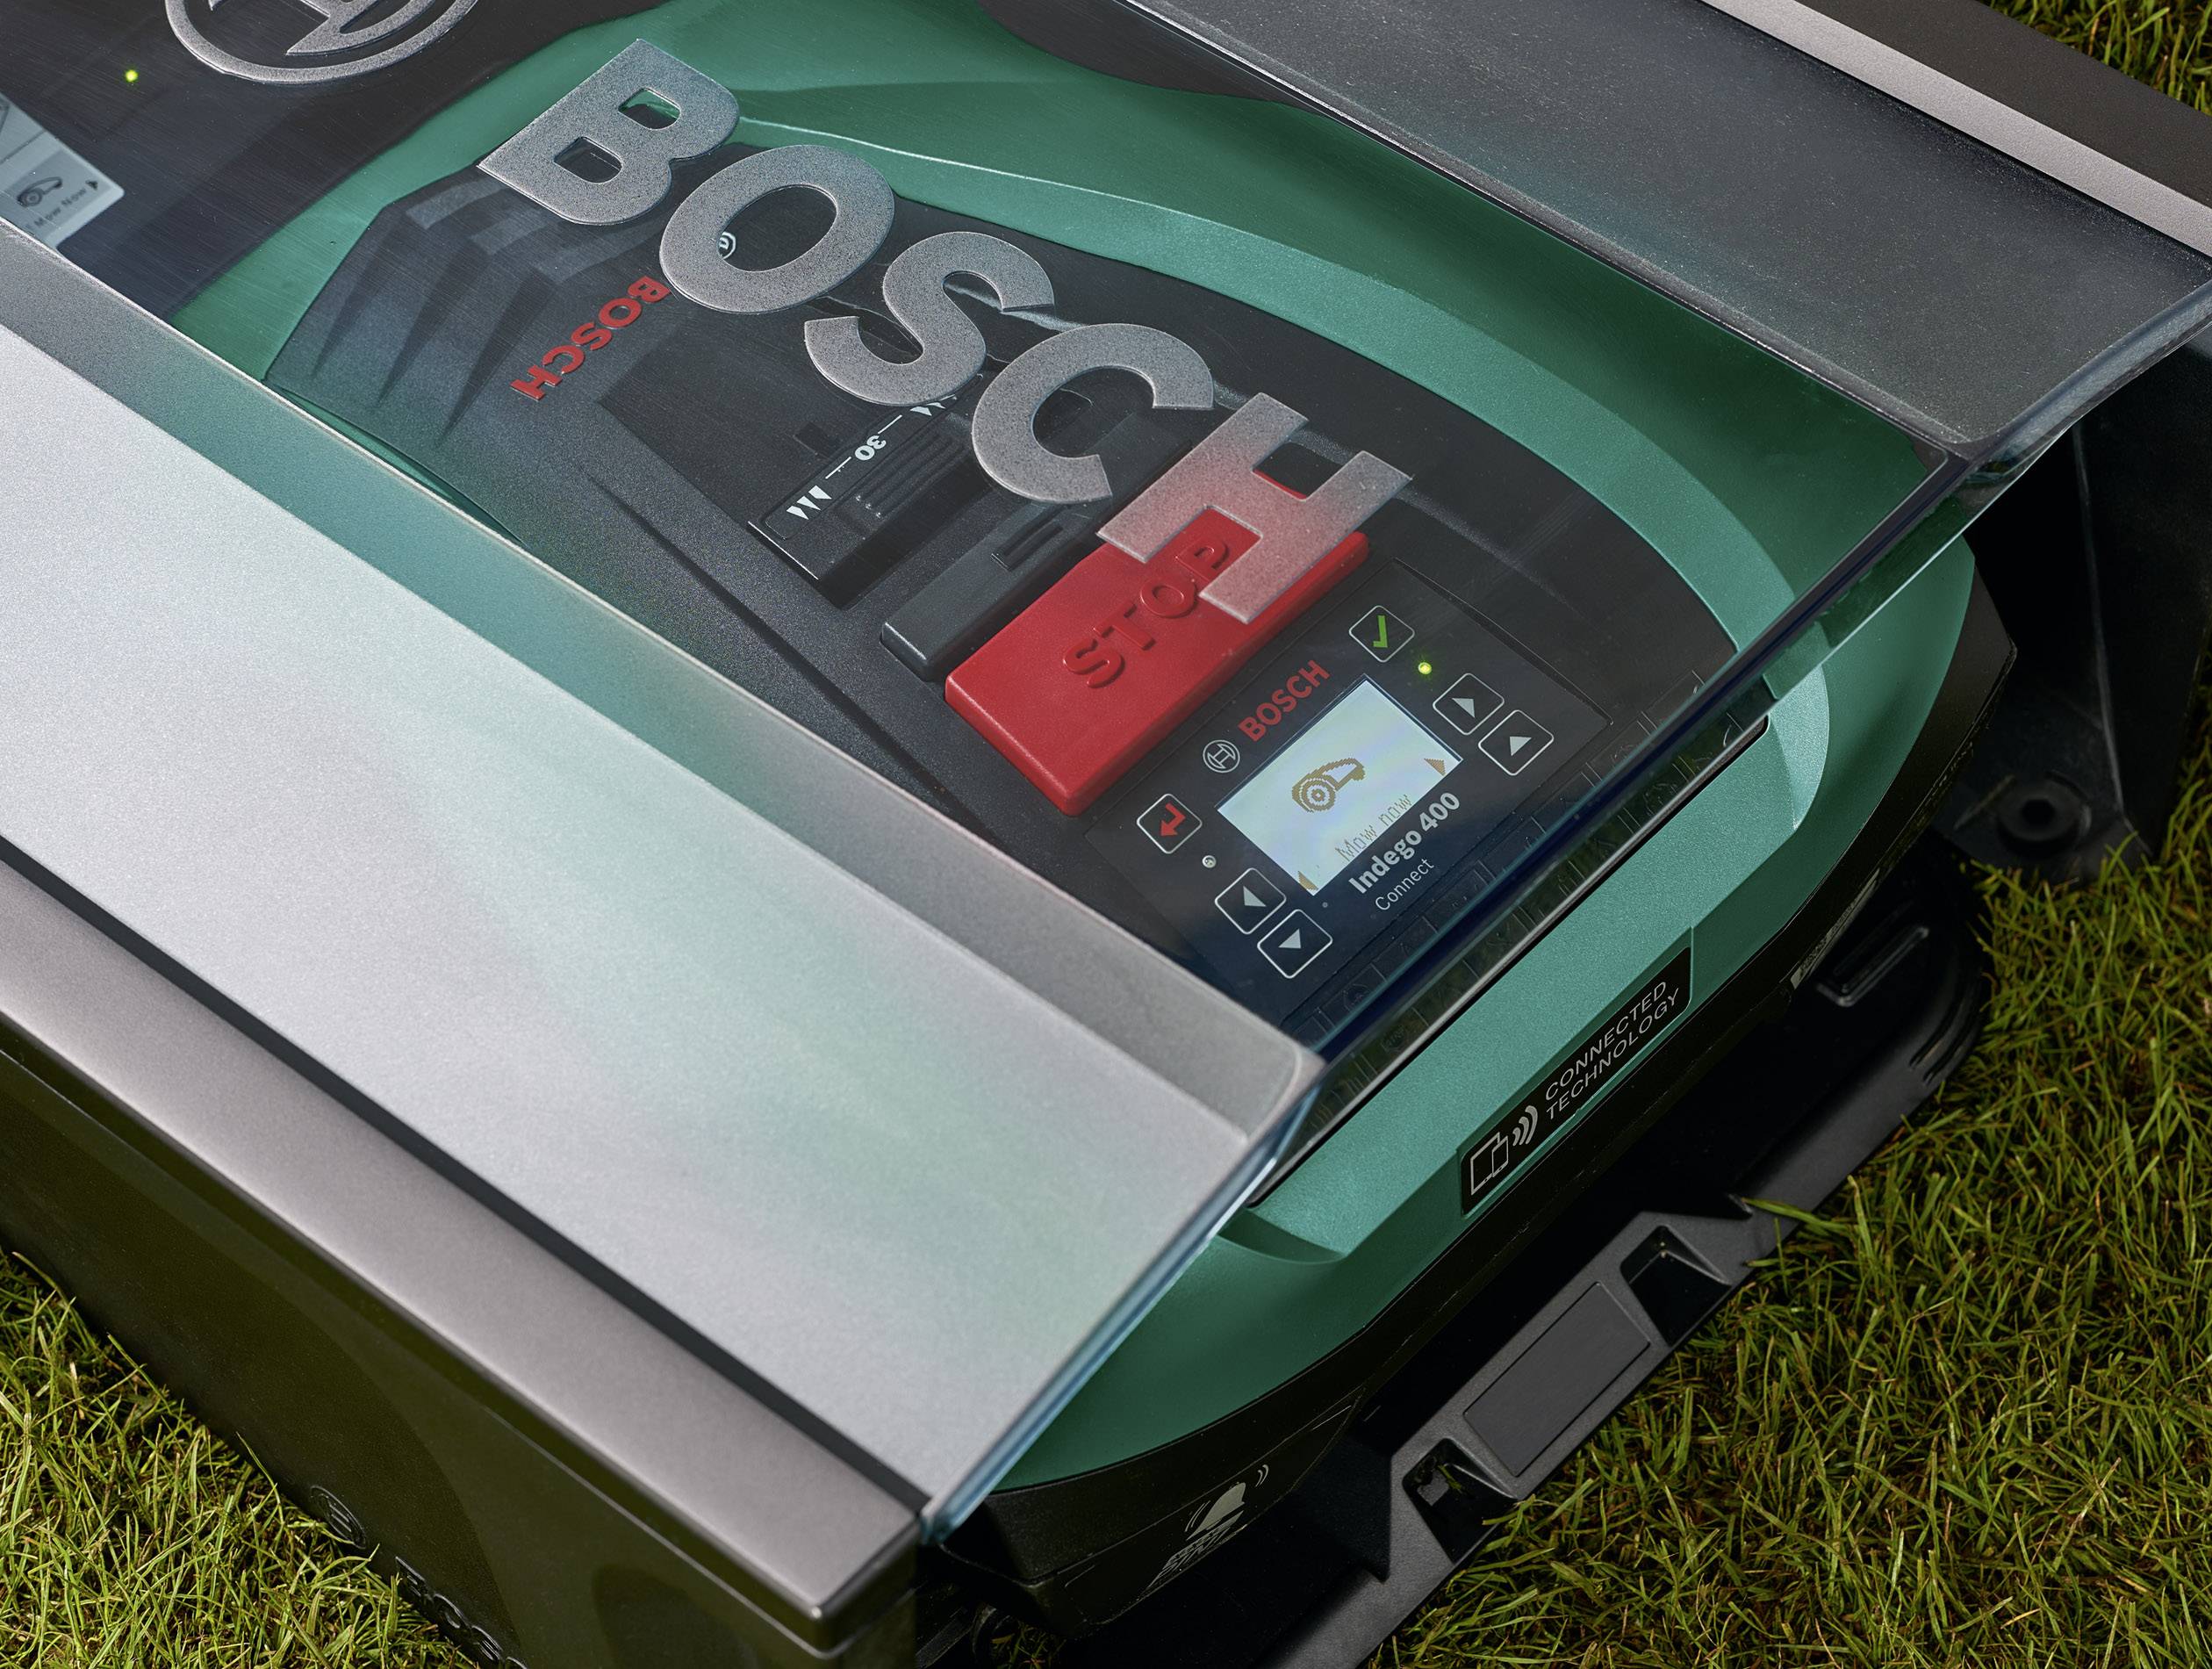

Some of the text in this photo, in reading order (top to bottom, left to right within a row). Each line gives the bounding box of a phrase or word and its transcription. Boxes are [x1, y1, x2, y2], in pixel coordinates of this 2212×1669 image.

[478, 39, 1415, 624] BOSCH
[509, 275, 672, 401] BOSCH
[854, 435, 887, 461] 30
[1062, 536, 1229, 689] STOP
[1238, 659, 1331, 742] BOSCH
[1334, 794, 1412, 863] Mow now
[1348, 792, 1461, 895] Indego 400
[1375, 857, 1435, 911] Connect
[1545, 981, 1667, 1101] CONNECTED
[1546, 987, 1679, 1120] TECHNOLOGY
